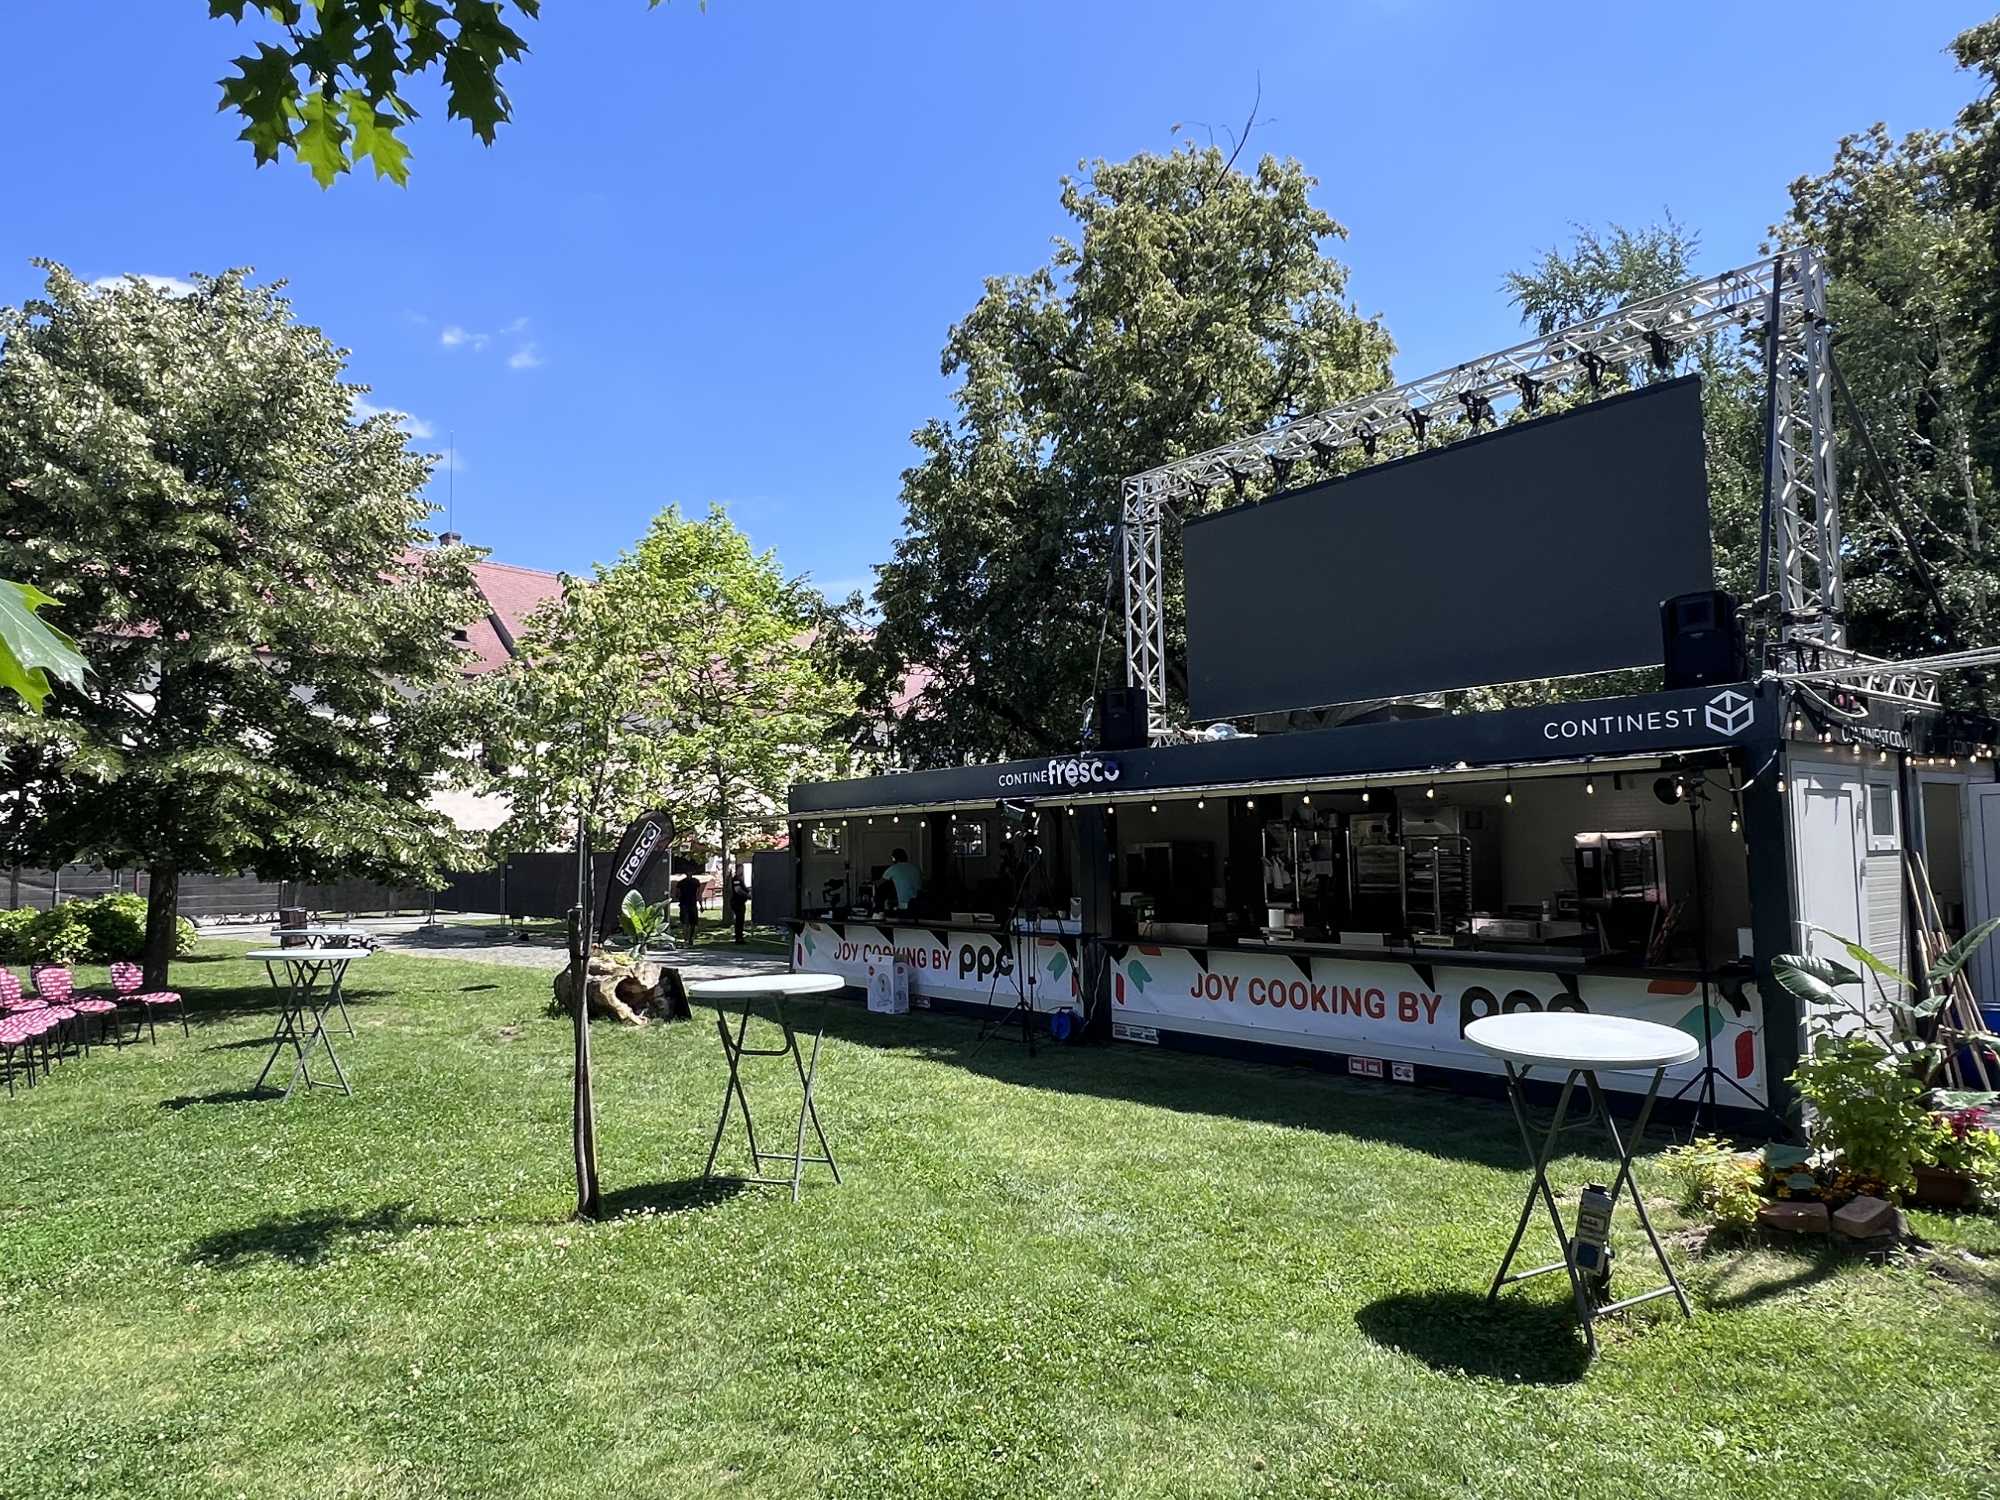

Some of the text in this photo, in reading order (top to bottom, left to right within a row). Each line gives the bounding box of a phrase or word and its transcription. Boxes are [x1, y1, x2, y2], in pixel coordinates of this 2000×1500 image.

[1543, 707, 1697, 741] CONTINEST
[619, 829, 657, 882] fresco
[834, 942, 859, 962] JOY
[932, 949, 952, 970] BY
[959, 944, 1014, 982] ppc
[1190, 973, 1239, 1002] JOY
[1247, 977, 1386, 1019] COOKING
[1398, 991, 1442, 1025] BY
